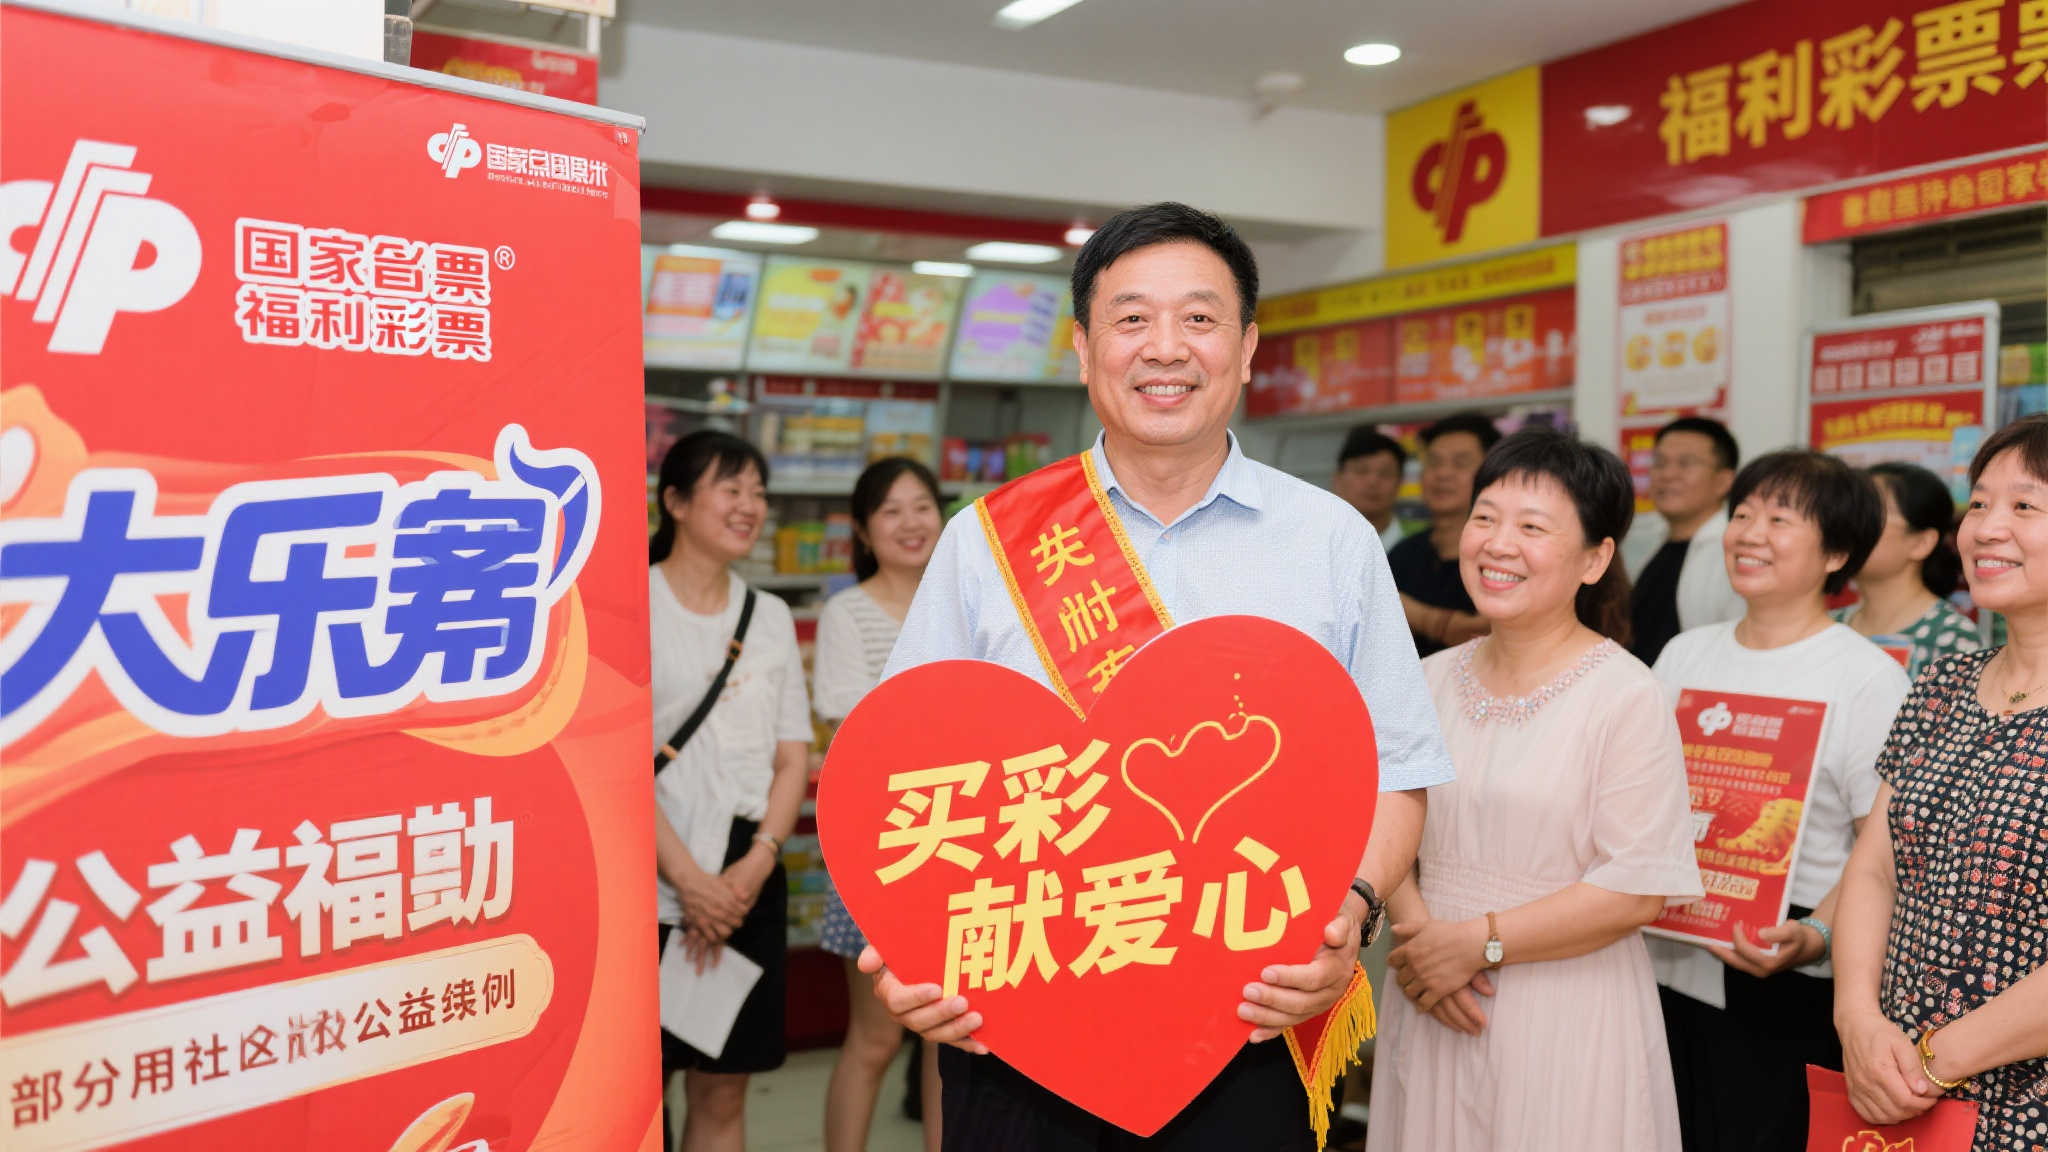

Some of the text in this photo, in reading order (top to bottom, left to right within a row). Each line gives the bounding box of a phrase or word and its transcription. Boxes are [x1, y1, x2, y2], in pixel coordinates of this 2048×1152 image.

[238, 286, 491, 361] 福利彩票
[874, 738, 1112, 887] 买彩
[941, 835, 1312, 998] 献爱心
